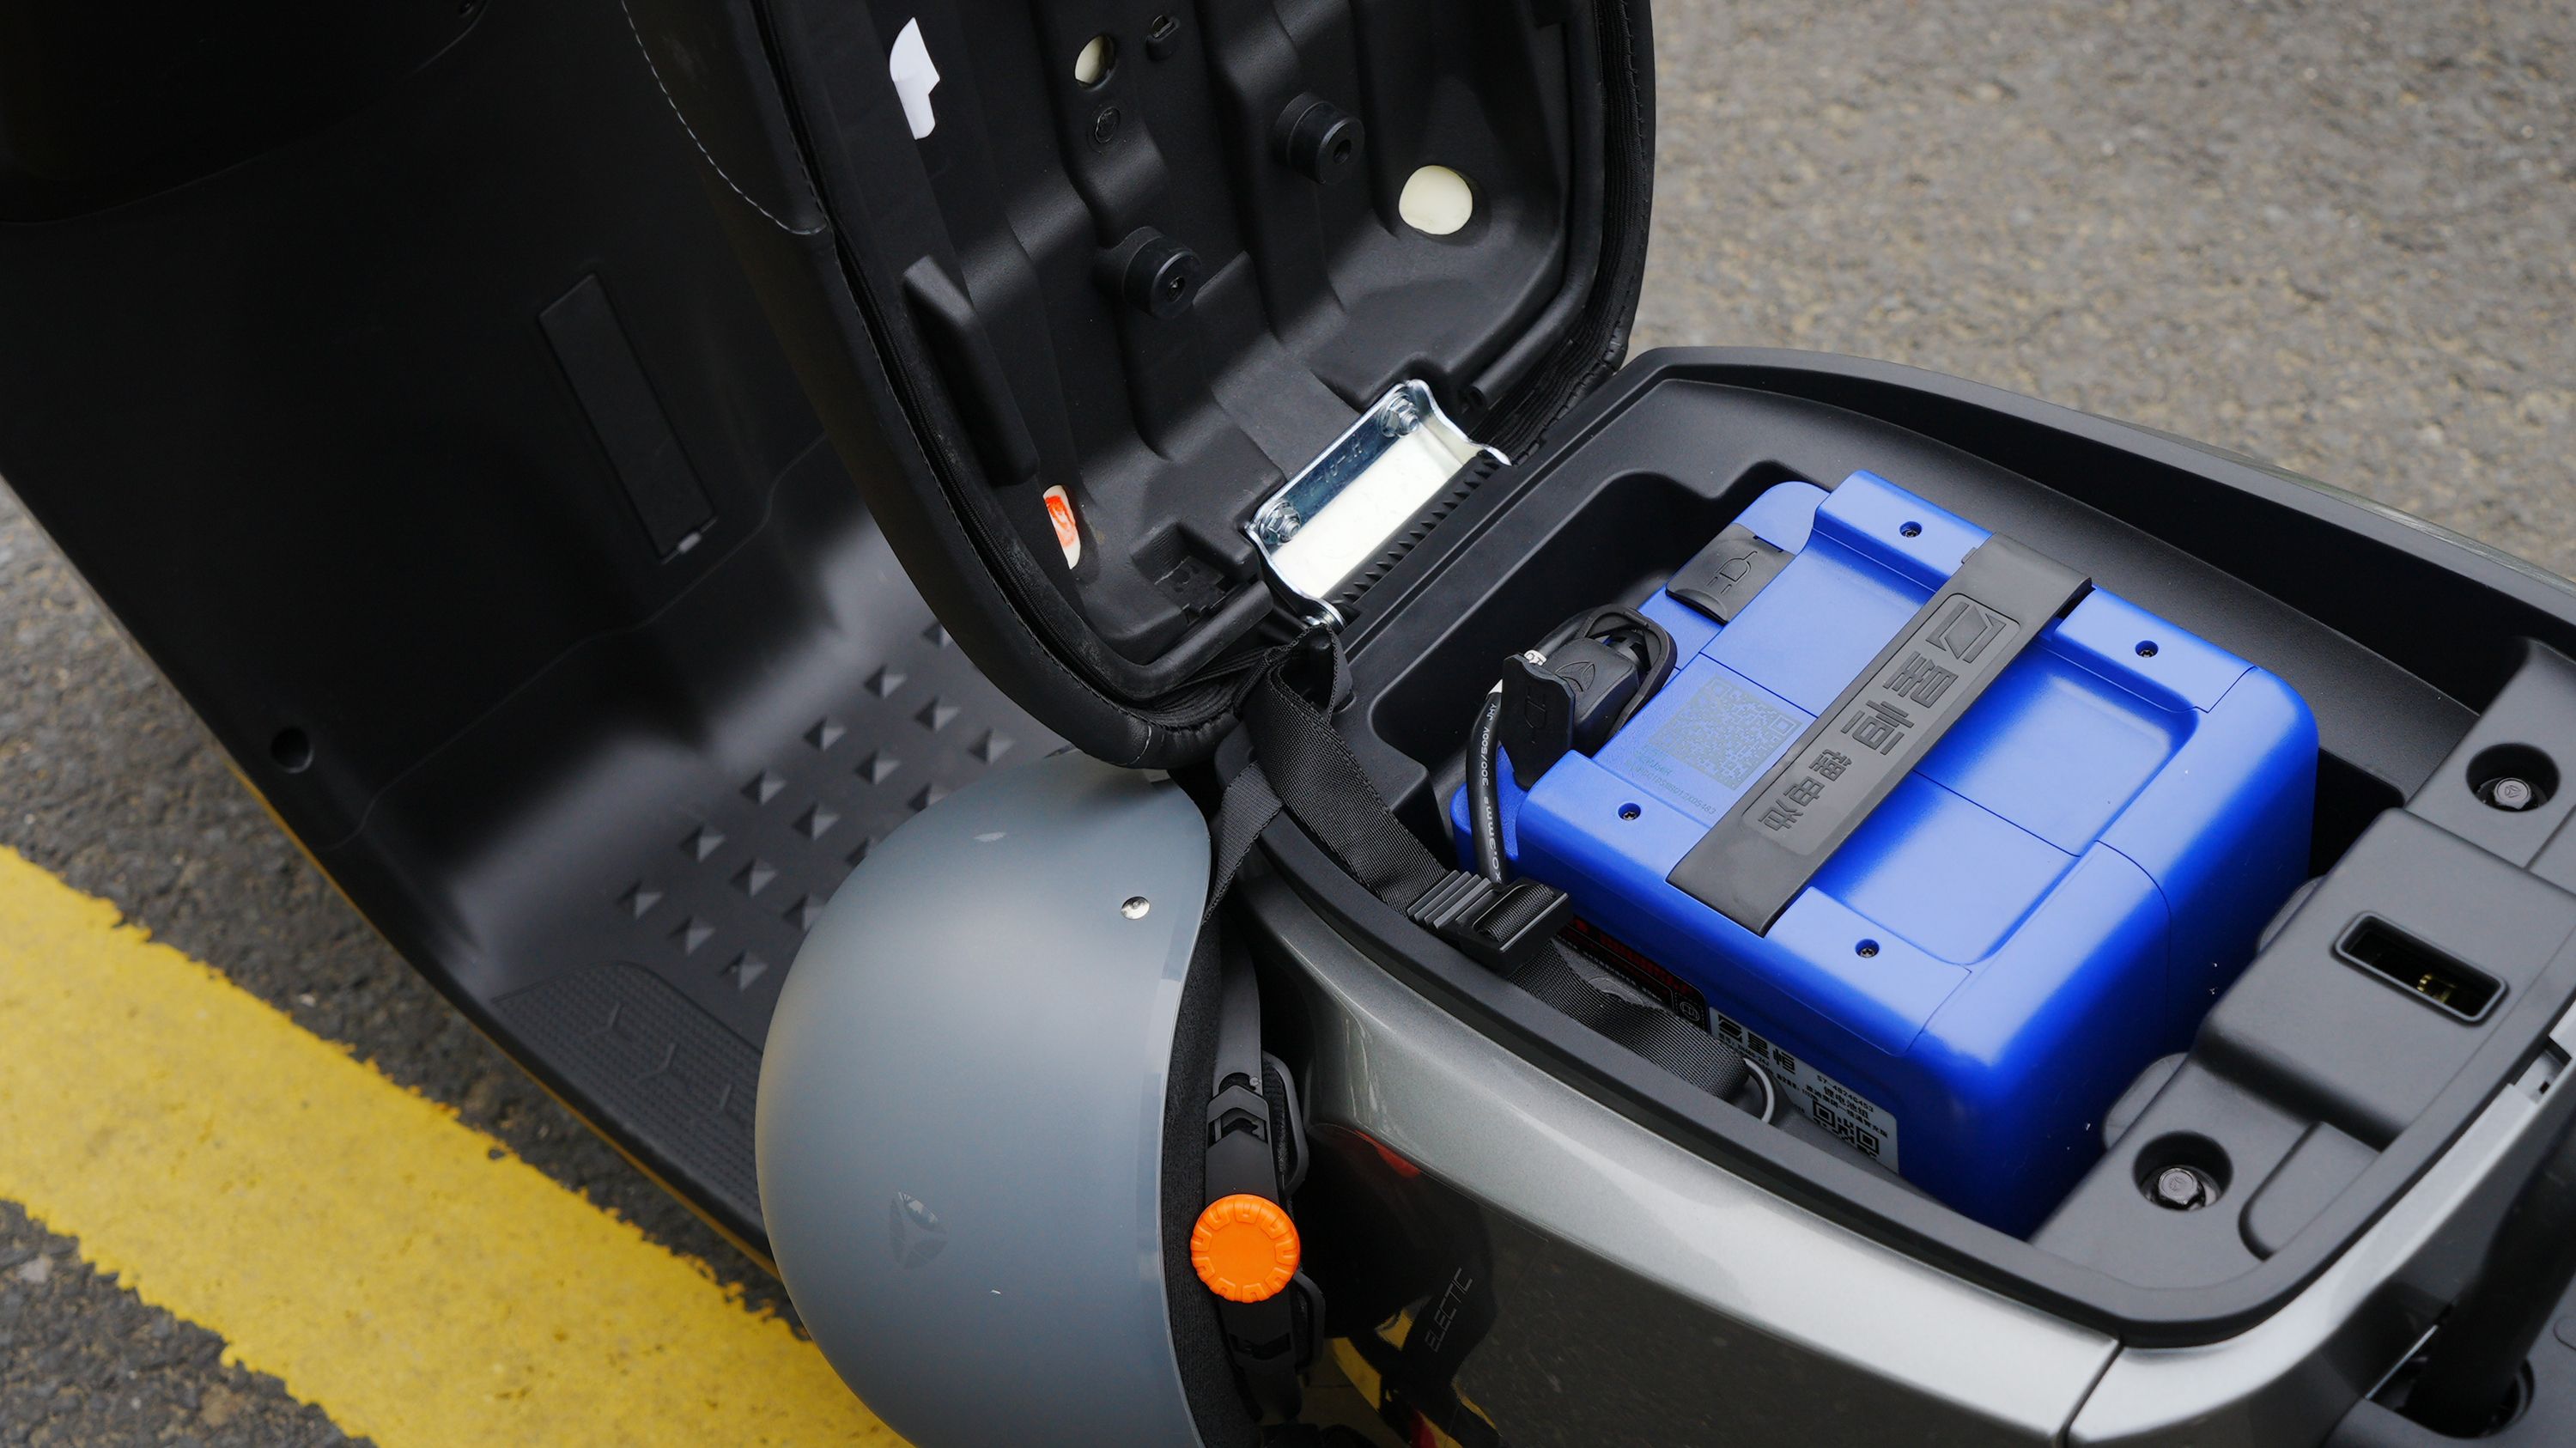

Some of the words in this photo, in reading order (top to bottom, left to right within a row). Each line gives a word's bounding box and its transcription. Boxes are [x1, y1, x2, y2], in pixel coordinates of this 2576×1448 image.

[1481, 727, 1491, 786] 300/500V
[1486, 703, 1497, 721] JHY
[1758, 749, 1853, 831] 锂电池
[1748, 1031, 1795, 1074] 星恒
